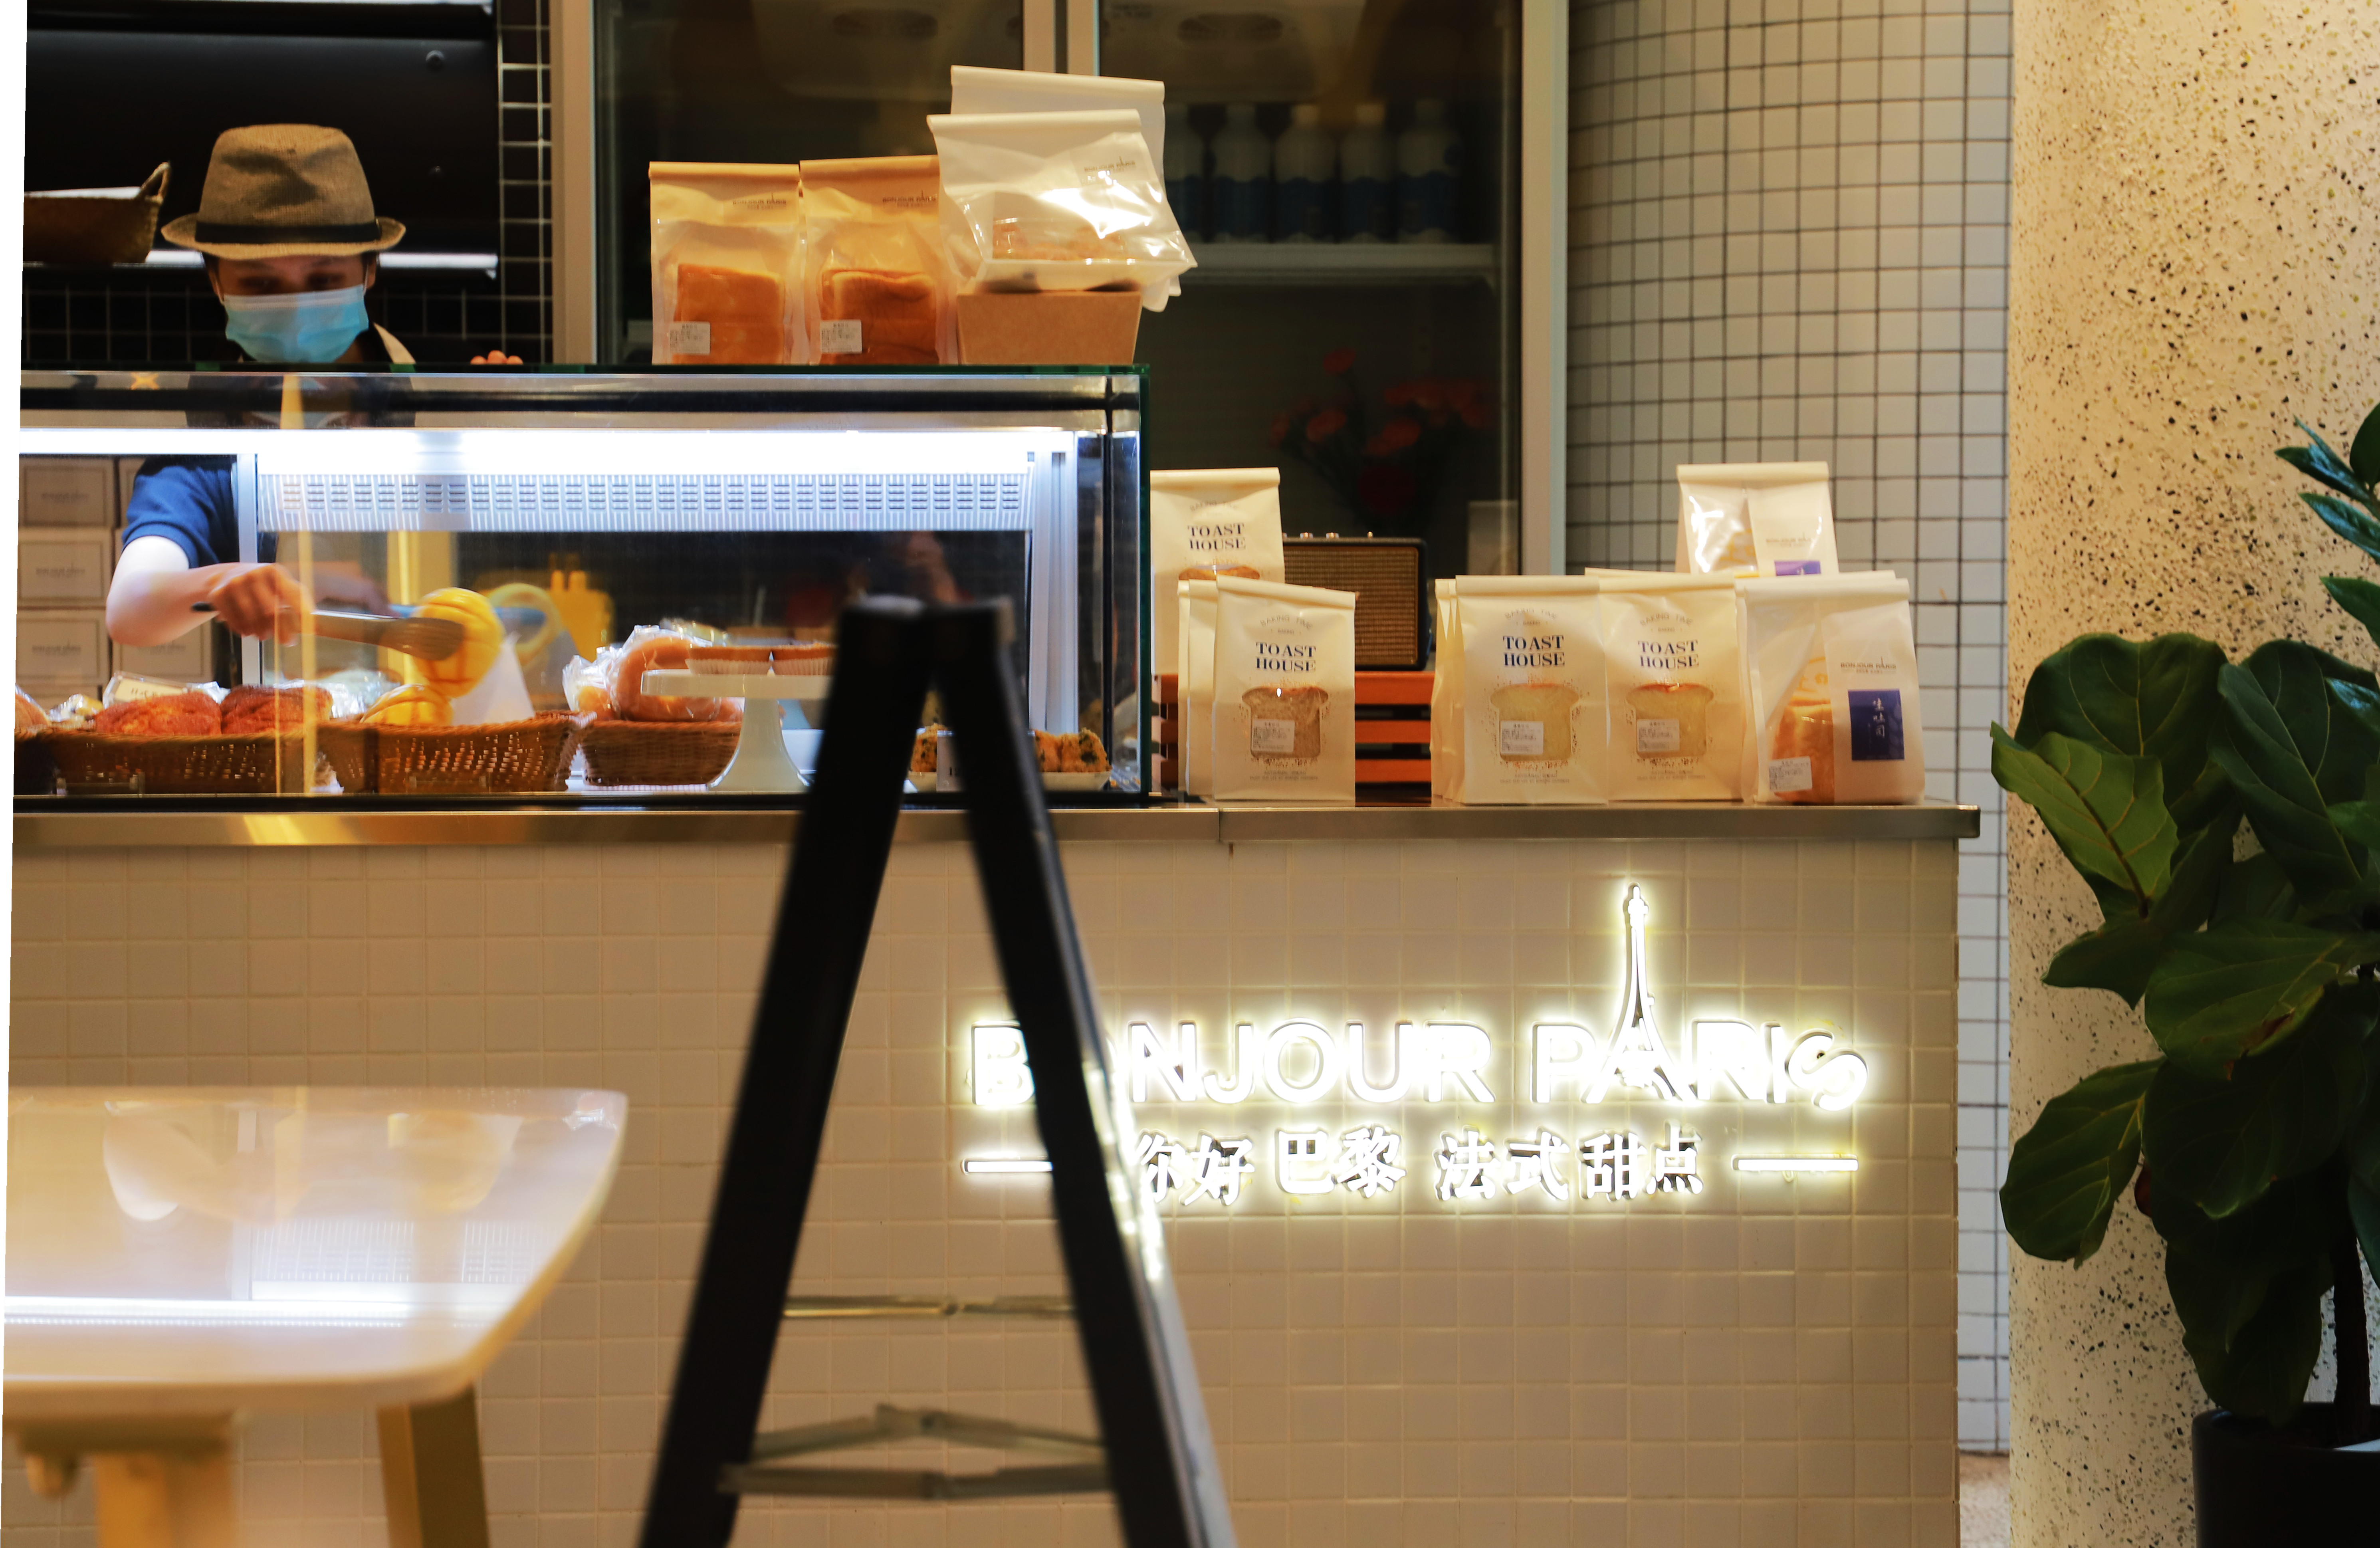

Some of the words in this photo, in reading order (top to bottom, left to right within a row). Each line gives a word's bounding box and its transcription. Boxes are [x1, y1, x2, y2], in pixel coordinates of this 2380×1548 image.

[1187, 523, 1245, 537] TOAST
[1189, 537, 1246, 552] HOUSE
[1260, 614, 1290, 627] BAKING
[1640, 612, 1670, 626] BAKING
[1256, 642, 1316, 657] TOAST
[1502, 635, 1564, 650] TOAST
[1638, 640, 1698, 654] TOAST
[1256, 656, 1316, 673] HOUSE
[1504, 652, 1565, 668] HOUSE
[1640, 654, 1699, 670] HOUSE
[971, 1017, 1496, 1105] BNJOUR
